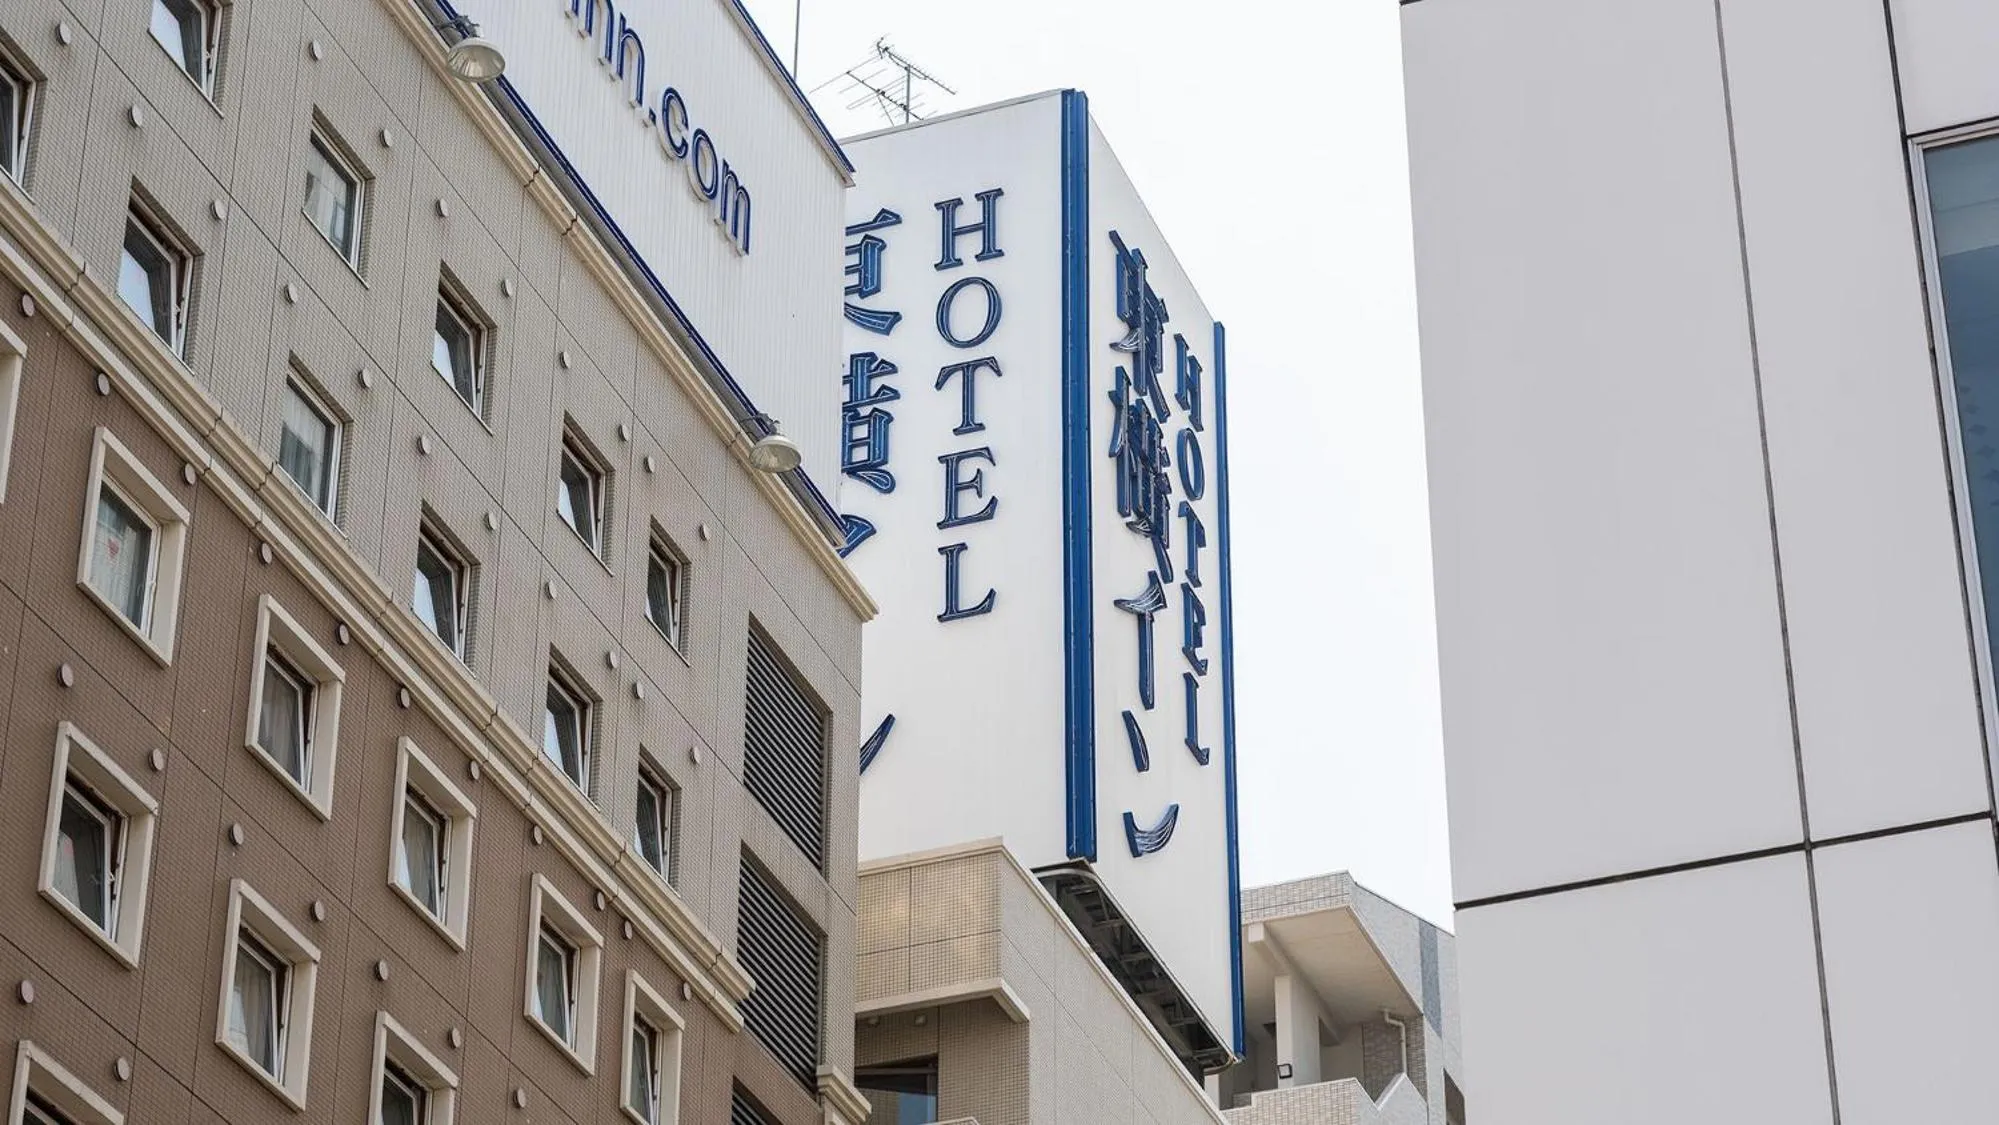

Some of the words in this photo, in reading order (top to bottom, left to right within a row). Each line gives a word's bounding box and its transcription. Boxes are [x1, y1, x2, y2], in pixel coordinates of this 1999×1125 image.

[566, 0, 751, 256] nn.com
[935, 188, 1004, 623] HOTEL
[1174, 333, 1210, 766] HOTEL
